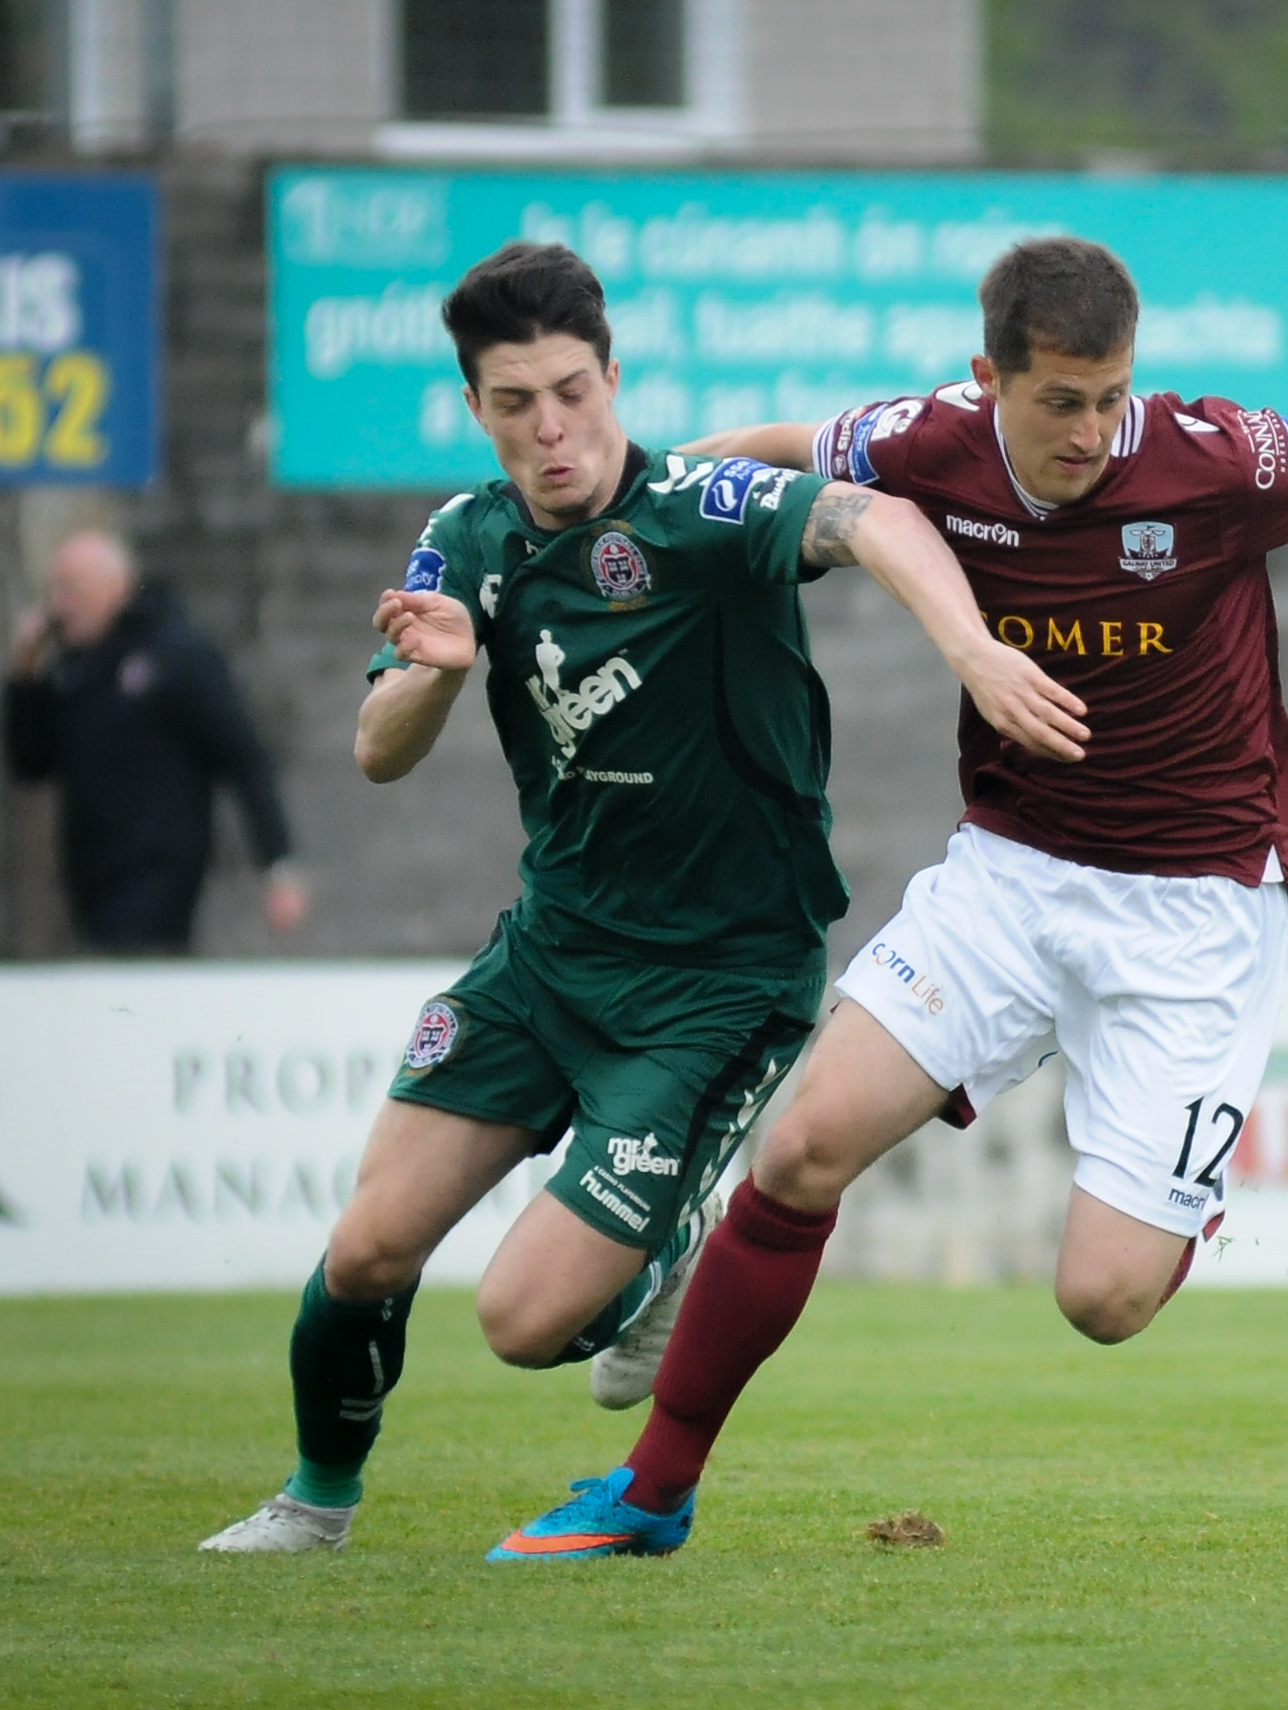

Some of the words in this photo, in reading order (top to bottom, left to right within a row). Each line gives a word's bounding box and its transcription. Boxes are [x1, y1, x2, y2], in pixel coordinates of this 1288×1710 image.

[946, 514, 1020, 548] macron
[979, 610, 1174, 656] OMER
[911, 974, 944, 1016] Life
[612, 1150, 679, 1177] green
[1171, 1095, 1244, 1188] 12
[579, 1169, 651, 1233] hummel
